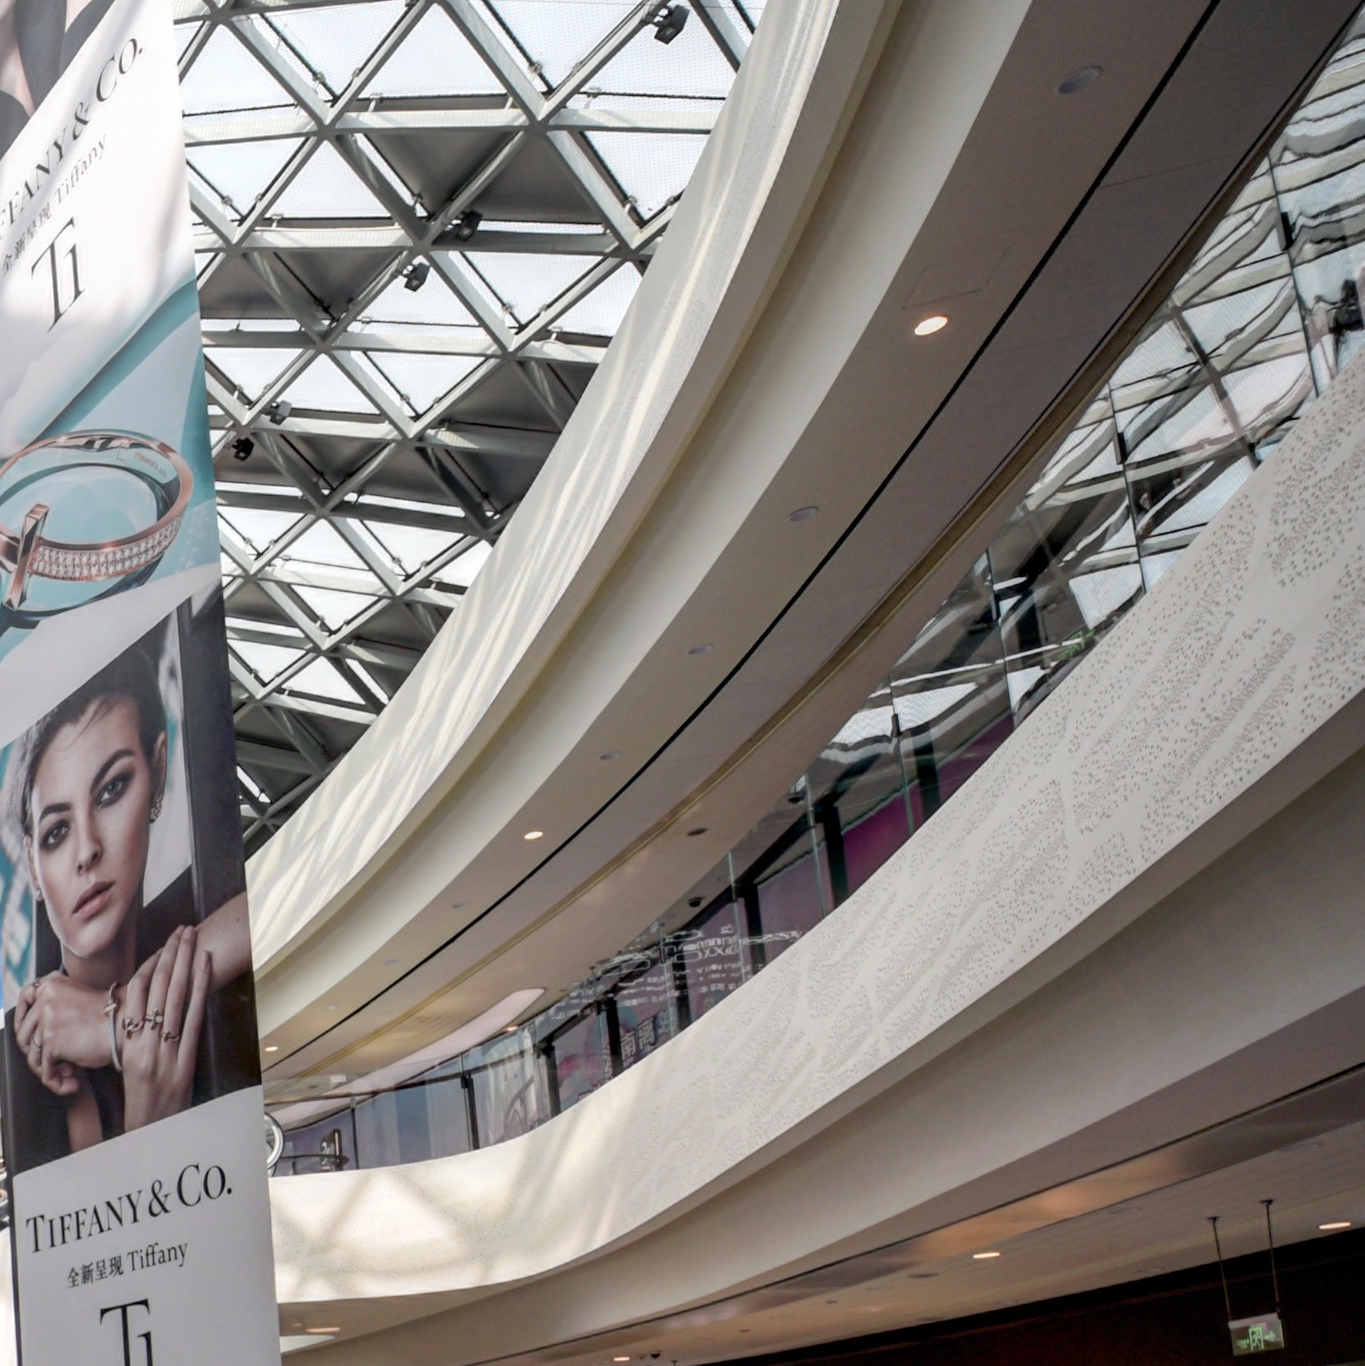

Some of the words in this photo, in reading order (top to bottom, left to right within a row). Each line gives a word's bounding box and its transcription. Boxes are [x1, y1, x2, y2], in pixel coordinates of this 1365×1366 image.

[53, 133, 108, 204] Tiffany
[66, 1254, 124, 1289] 全新呈现
[126, 1242, 189, 1273] Tiffany
